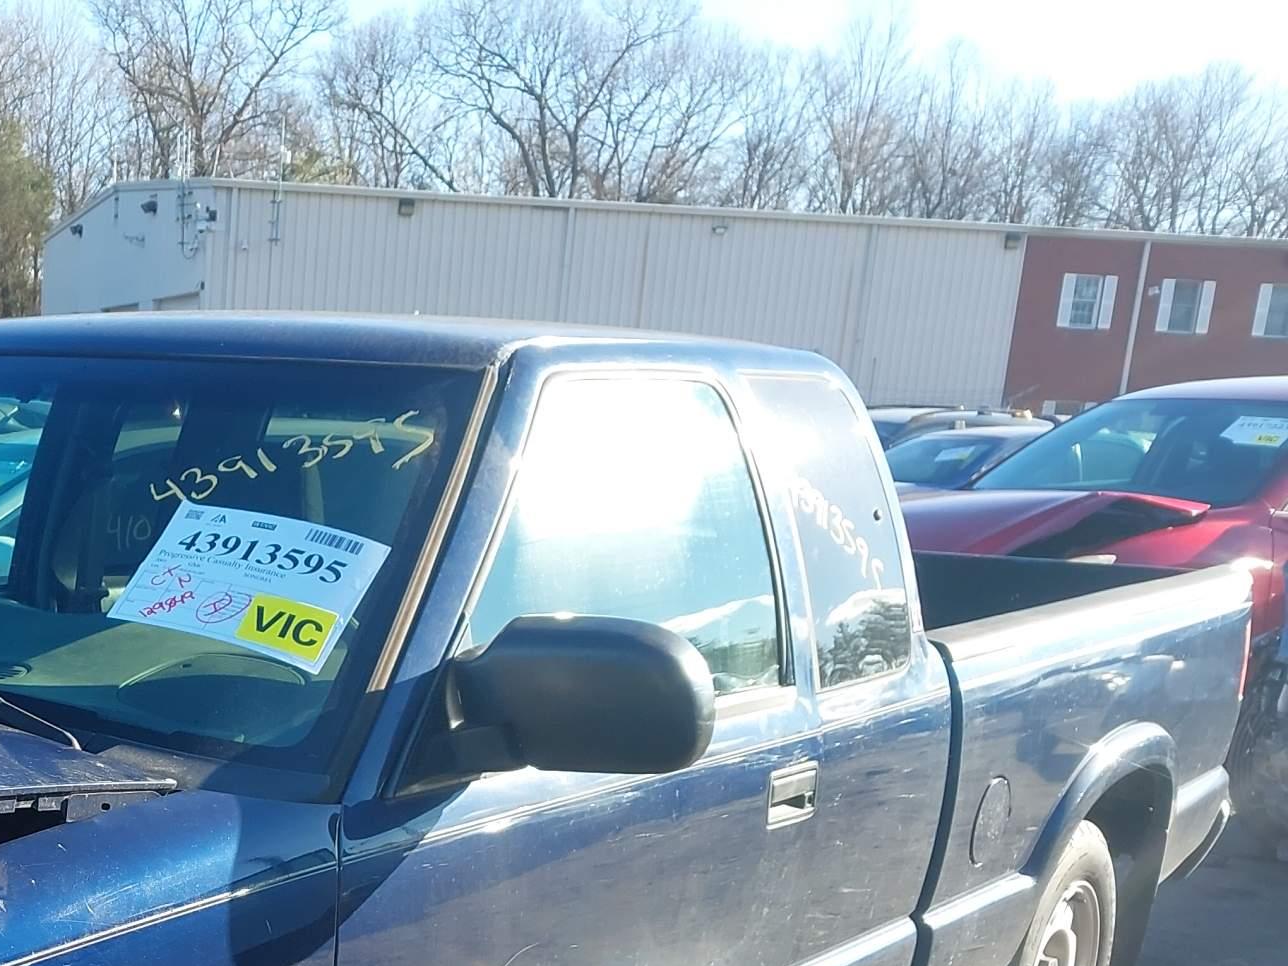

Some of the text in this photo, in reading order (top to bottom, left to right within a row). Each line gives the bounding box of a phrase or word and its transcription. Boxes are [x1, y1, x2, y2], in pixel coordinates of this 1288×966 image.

[150, 410, 434, 501] 43913595
[159, 548, 207, 562] Progressive
[208, 556, 243, 570] Casualty
[244, 561, 287, 579] Insurance
[178, 530, 348, 584] 43913595
[255, 604, 324, 647] VIC
